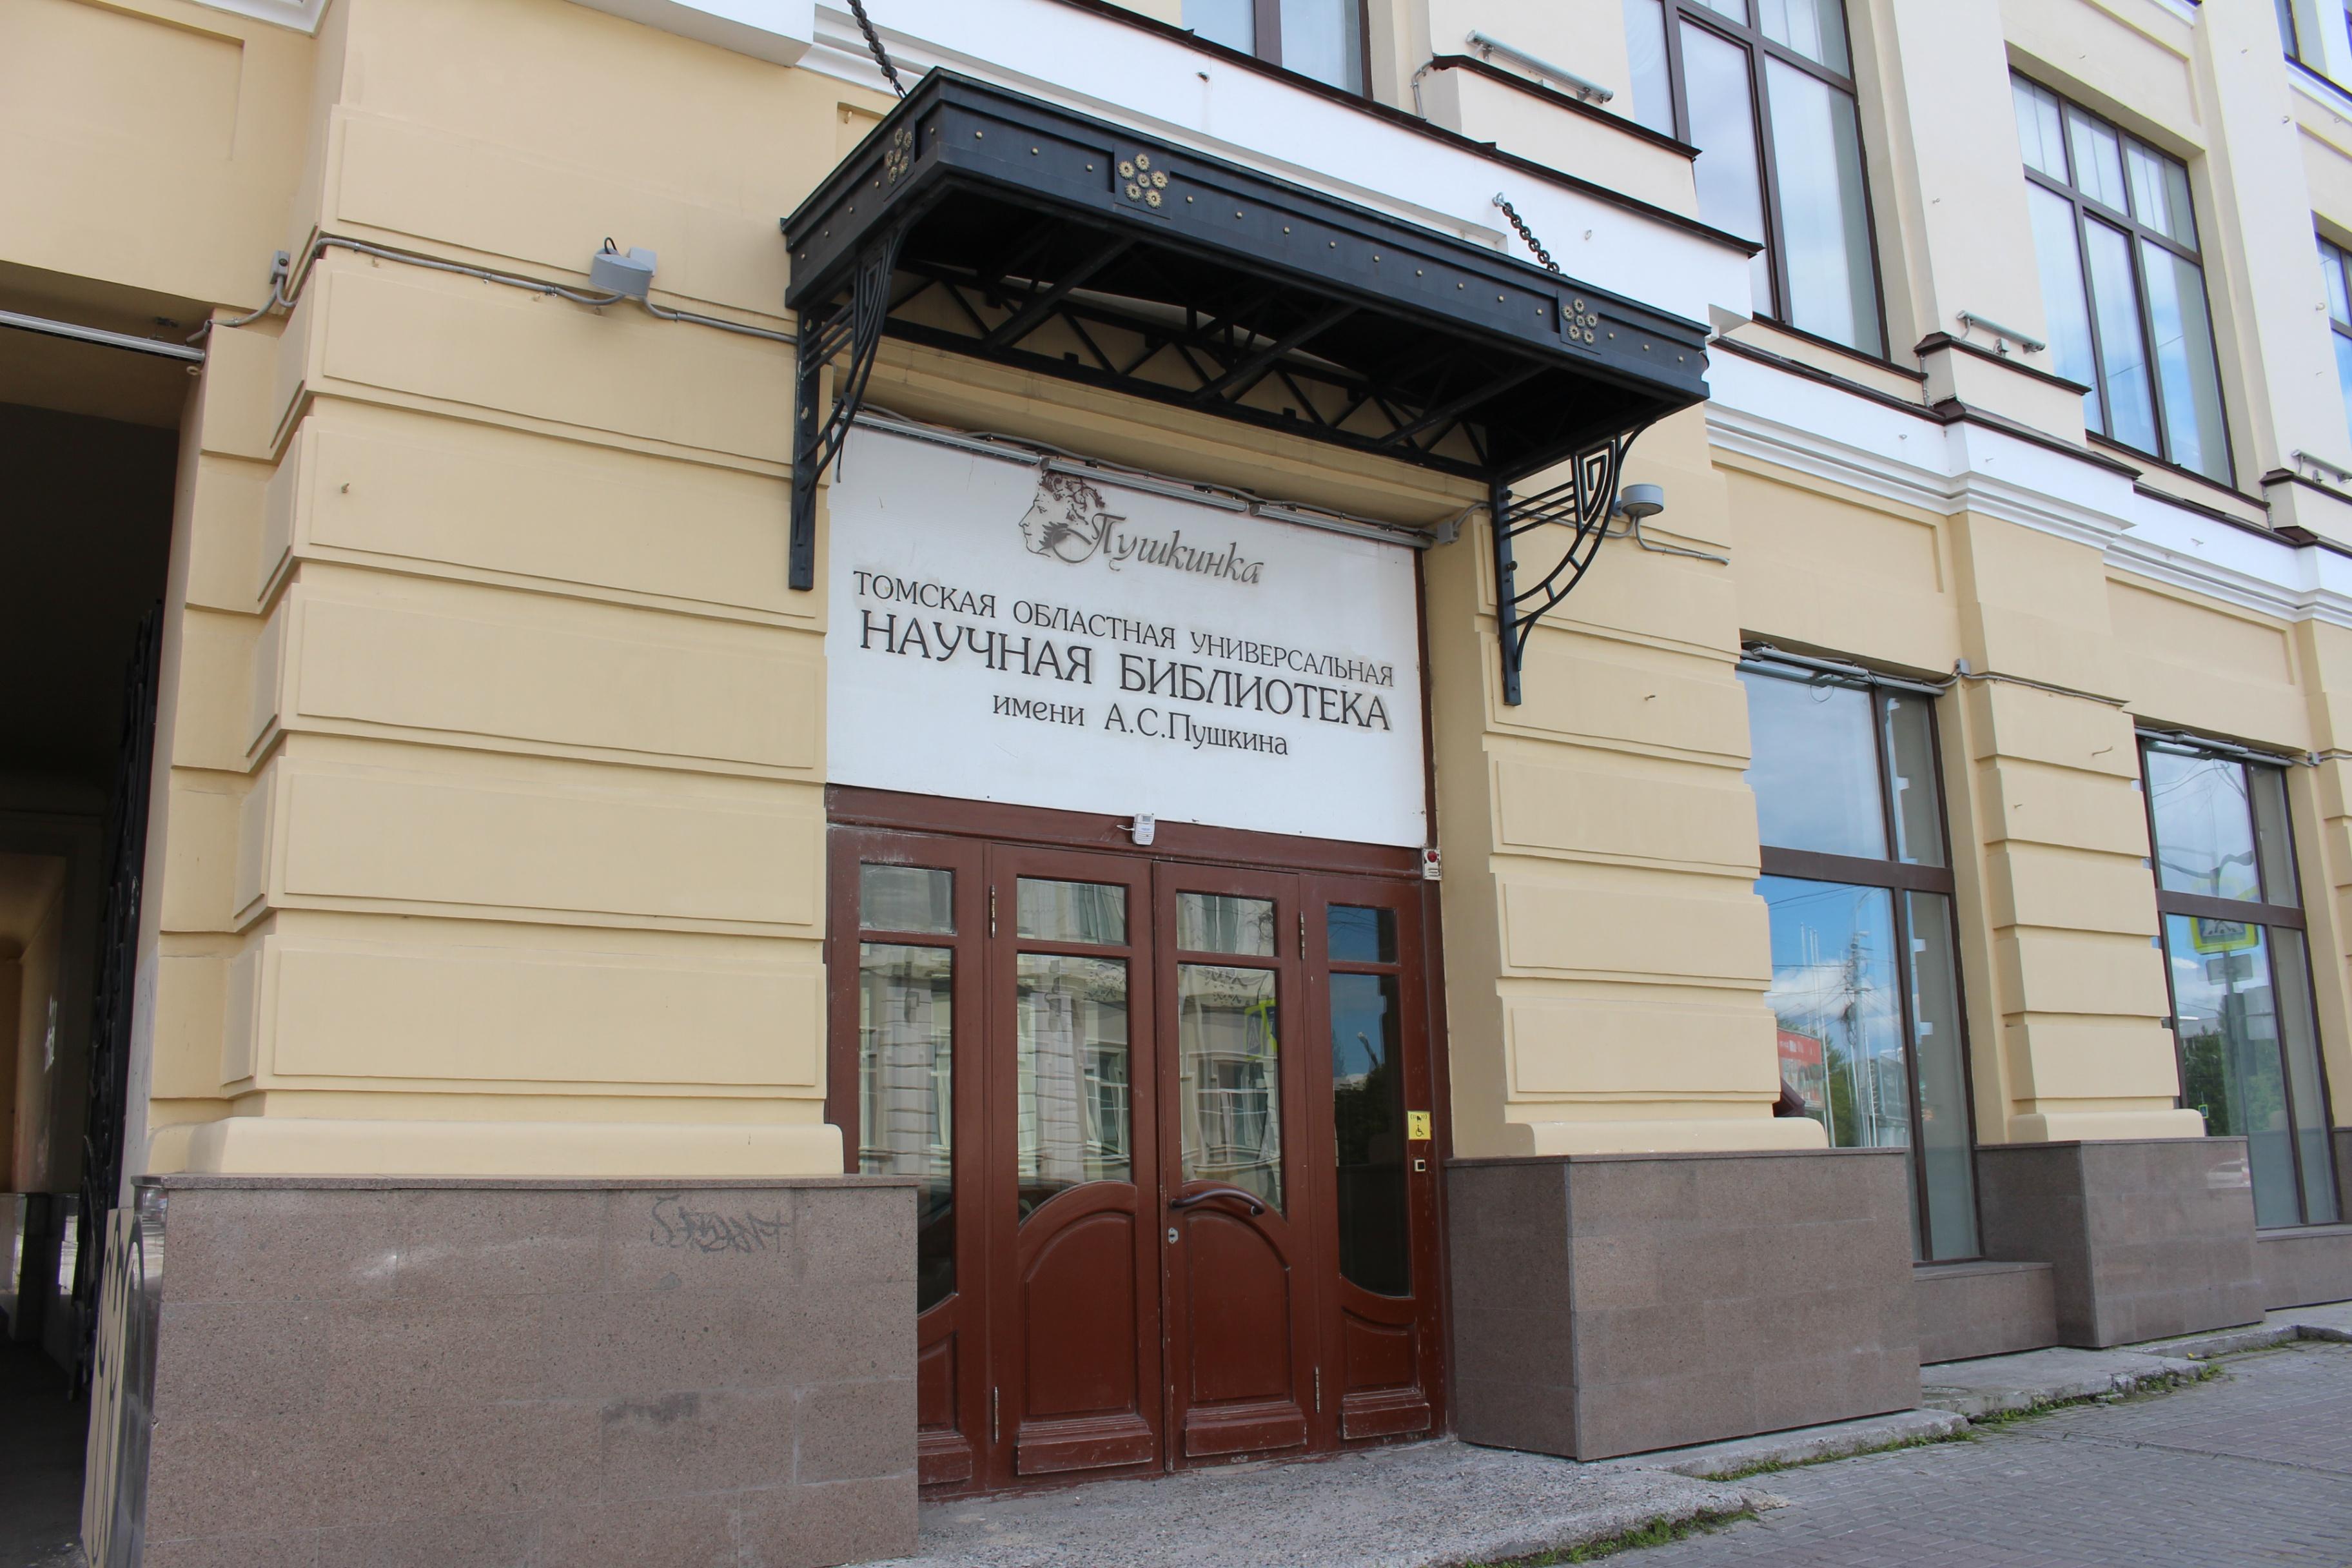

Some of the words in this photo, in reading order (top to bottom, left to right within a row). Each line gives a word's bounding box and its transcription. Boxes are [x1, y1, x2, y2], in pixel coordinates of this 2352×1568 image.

[1052, 512, 1264, 584] Пушкинка
[853, 570, 996, 619] ТОМСКАЯ
[1013, 600, 1176, 650] ОБЛАСТНАЯ
[1190, 631, 1393, 687] УНИВЕРСАЛЬНАЯ
[859, 609, 1093, 685] НАУЧНАЯ
[1119, 652, 1391, 731] БИБЛИОТЕКА
[992, 694, 1085, 727] имени
[1104, 702, 1289, 756] А.С.Пушкина
